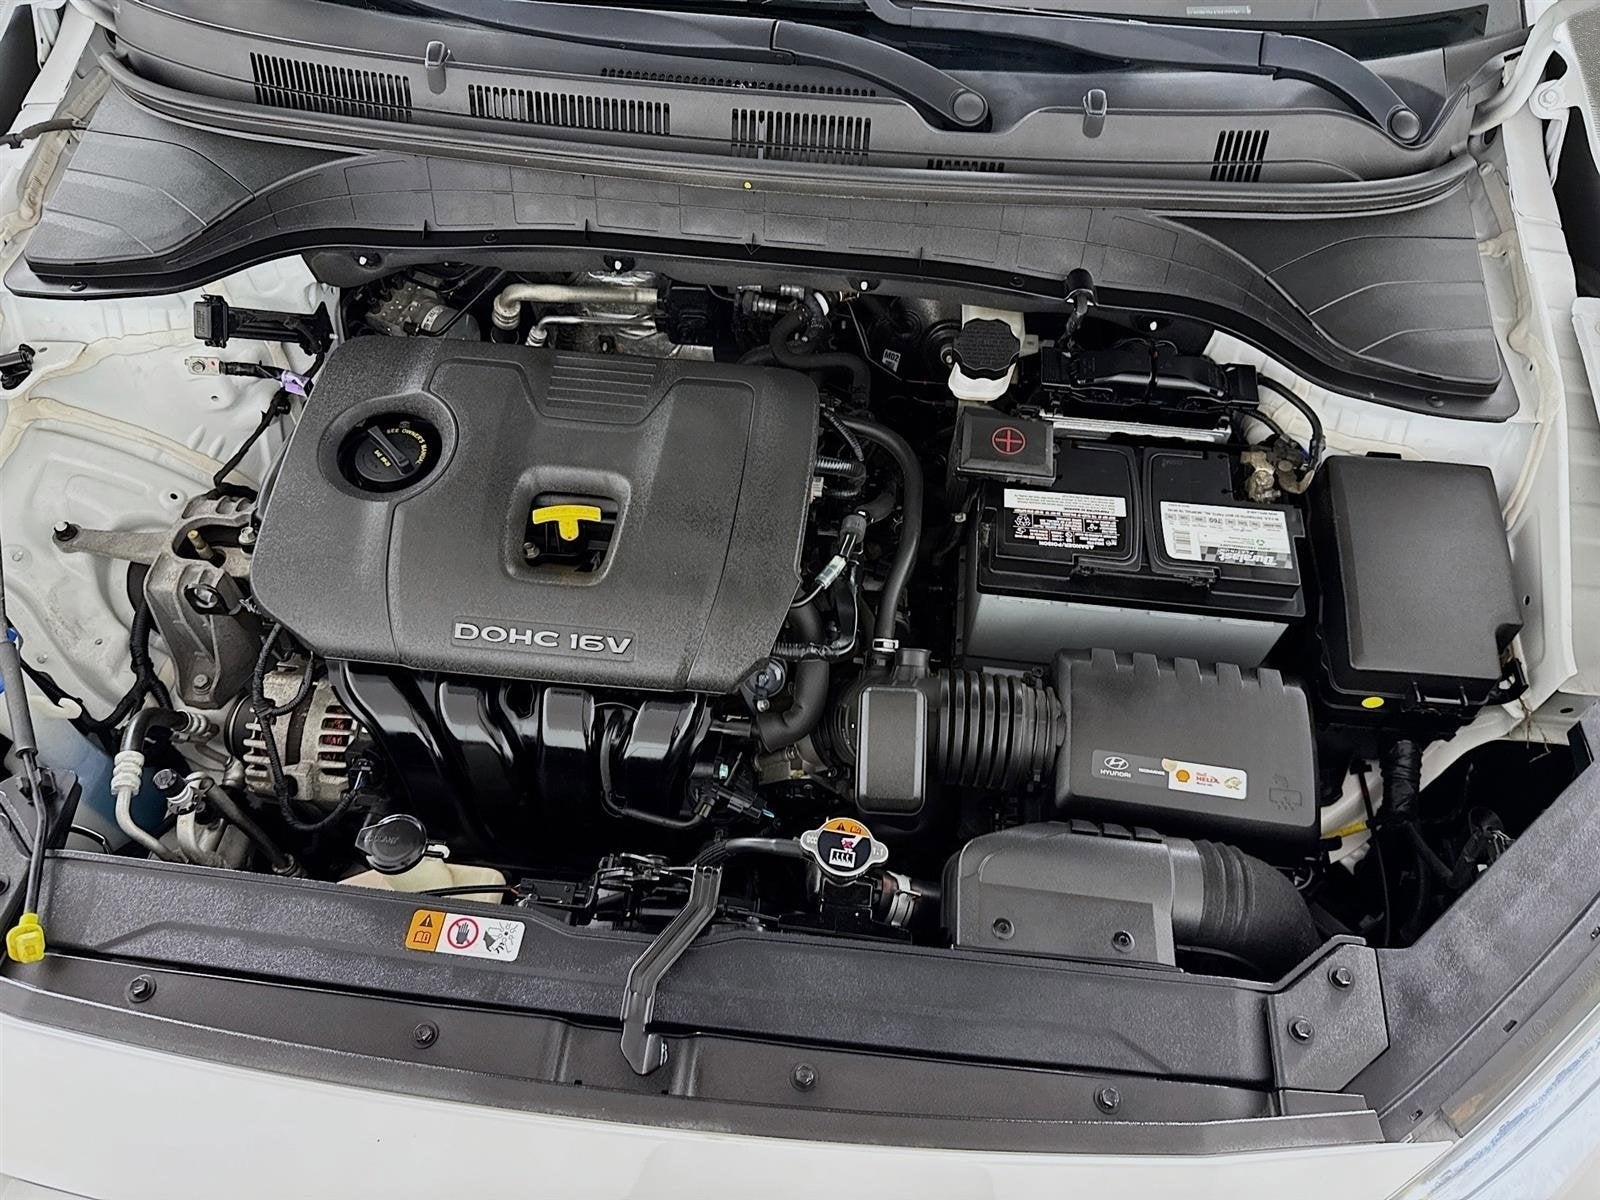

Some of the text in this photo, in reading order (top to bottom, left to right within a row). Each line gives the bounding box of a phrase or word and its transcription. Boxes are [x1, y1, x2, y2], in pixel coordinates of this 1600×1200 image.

[1218, 551, 1278, 566] Duralast
[454, 622, 632, 655] DOHC 16V
[1100, 768, 1132, 778] HYUNDAI
